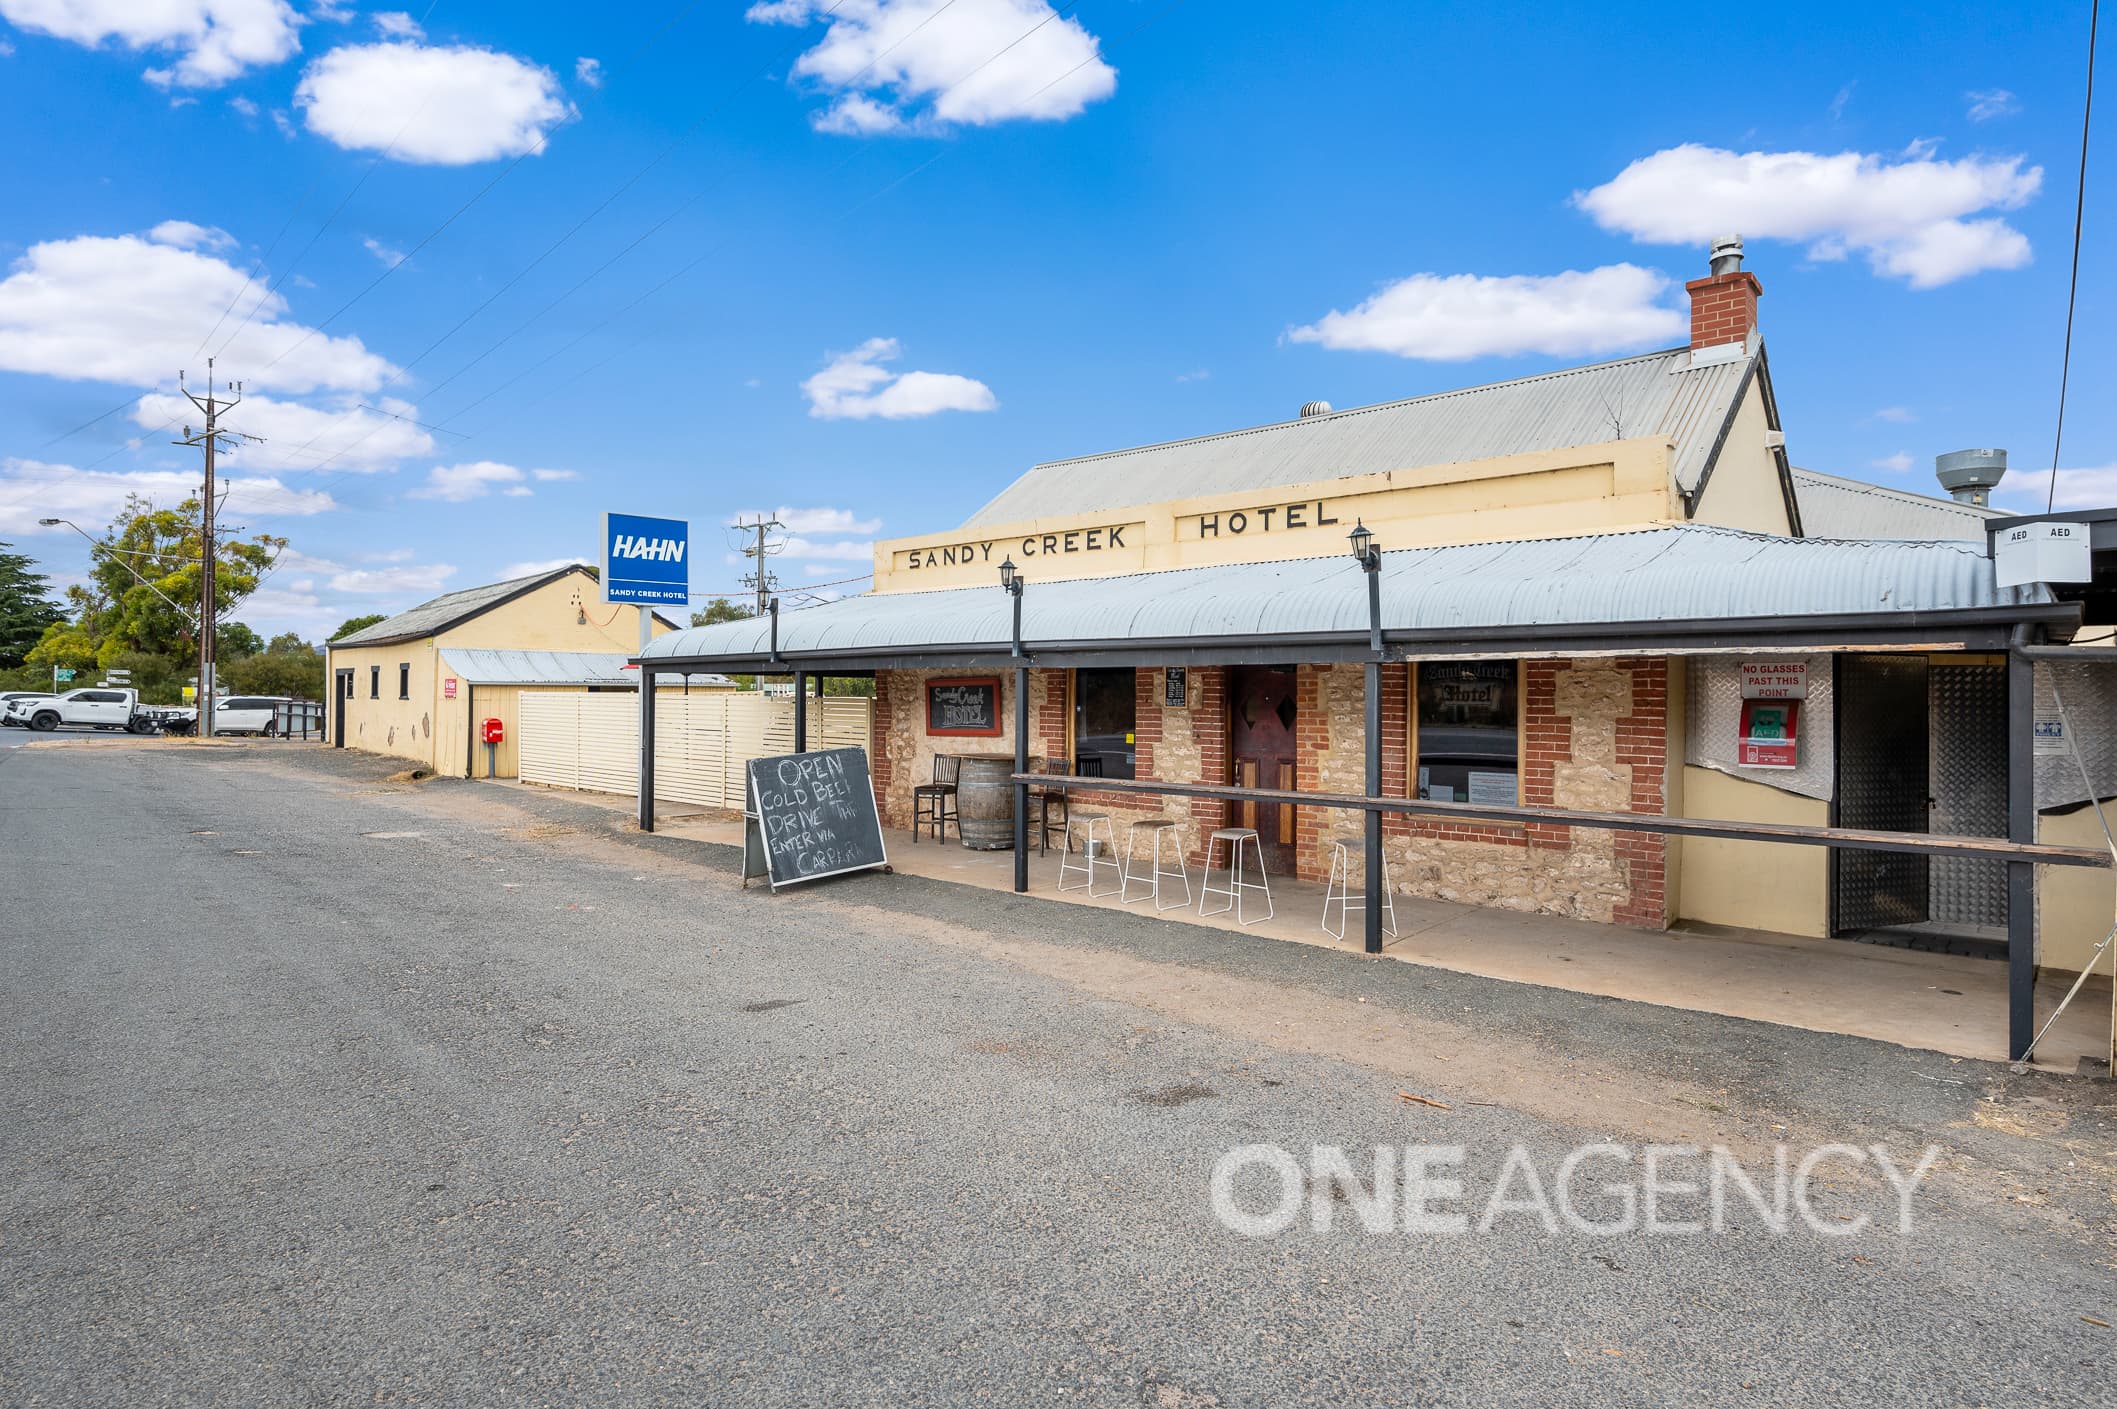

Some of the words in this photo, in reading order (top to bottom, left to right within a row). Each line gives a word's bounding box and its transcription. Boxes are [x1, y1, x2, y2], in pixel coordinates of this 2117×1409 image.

[908, 542, 993, 569] SANDY
[1022, 526, 1126, 557] CREEK
[1200, 502, 1338, 538] HOTEL
[2011, 530, 2027, 542] AED
[2050, 528, 2071, 537] AED
[612, 534, 685, 563] HAHN
[610, 588, 636, 597] SANDY
[637, 590, 662, 598] CREEK
[663, 591, 687, 599] HOTEL
[1743, 665, 1756, 673] NO
[1760, 664, 1805, 673] GLASSES
[1748, 677, 1771, 685] PAST
[1776, 677, 1799, 685] THIS
[1758, 688, 1789, 697] POINT
[777, 753, 844, 786] OPEN
[761, 789, 808, 811] COLD
[766, 806, 824, 835] DRIVE
[769, 831, 816, 855] ENTER
[816, 827, 836, 843] VIA
[796, 841, 864, 875] CARP
